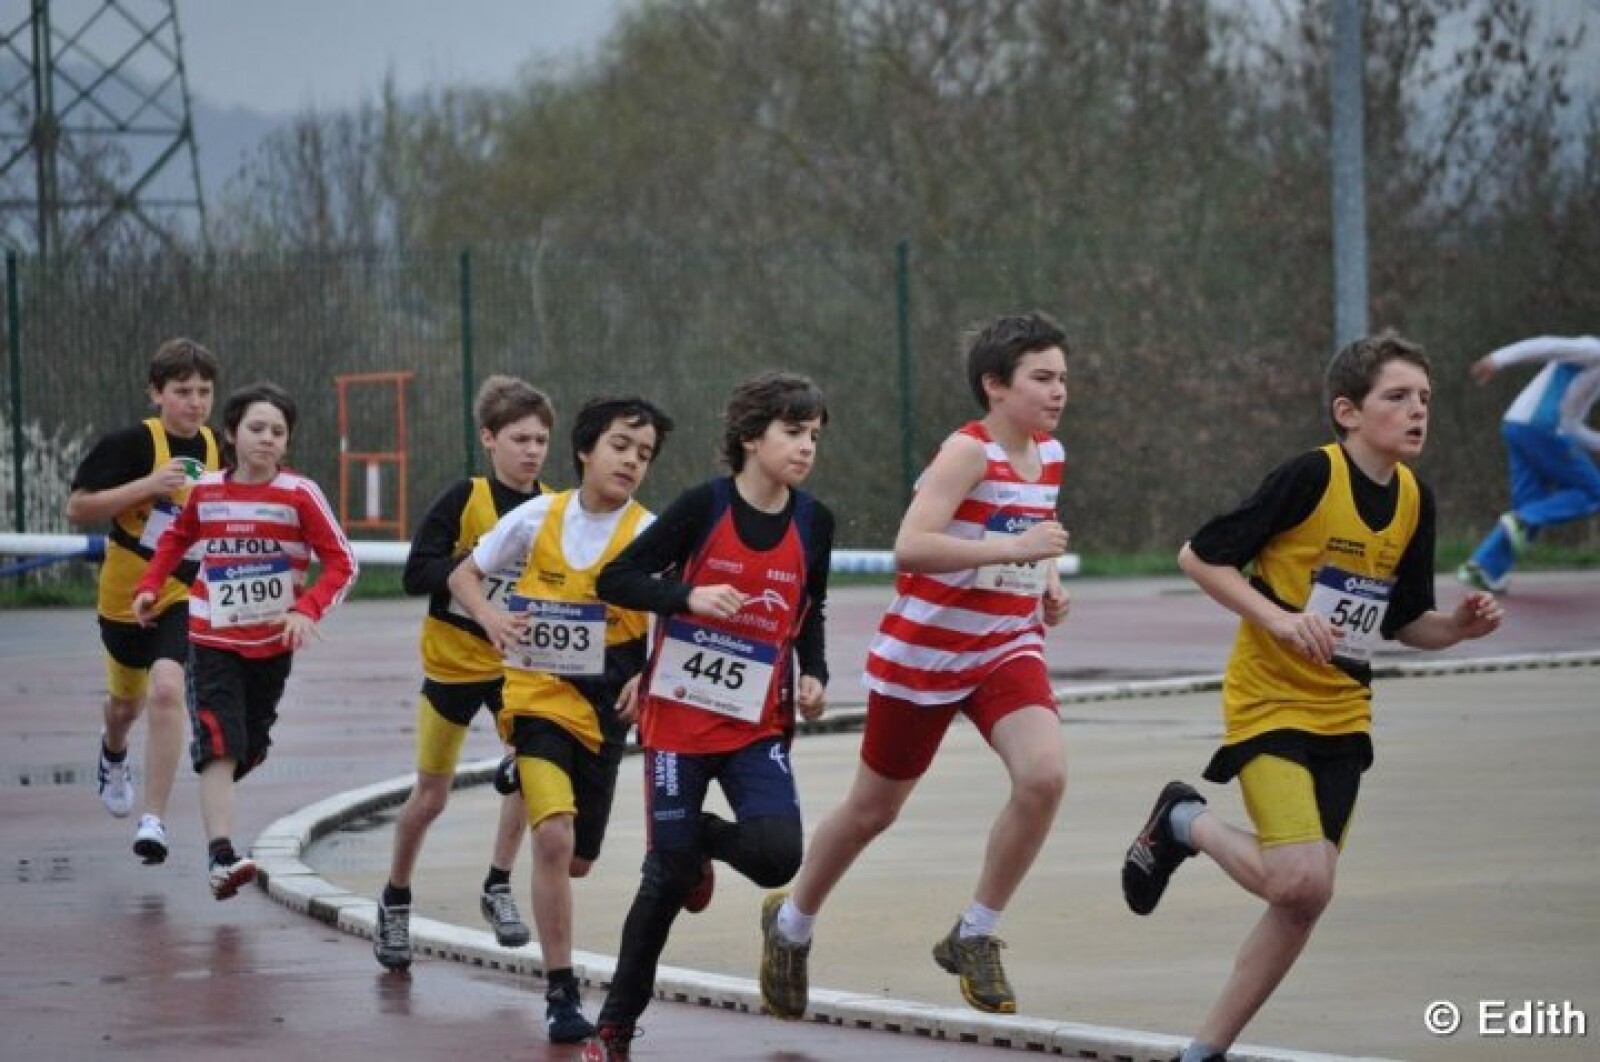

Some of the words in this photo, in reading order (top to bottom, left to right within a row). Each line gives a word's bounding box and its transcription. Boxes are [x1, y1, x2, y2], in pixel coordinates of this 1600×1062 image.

[219, 577, 283, 607] 2190
[1330, 599, 1379, 634] 540
[682, 652, 746, 689] 445
